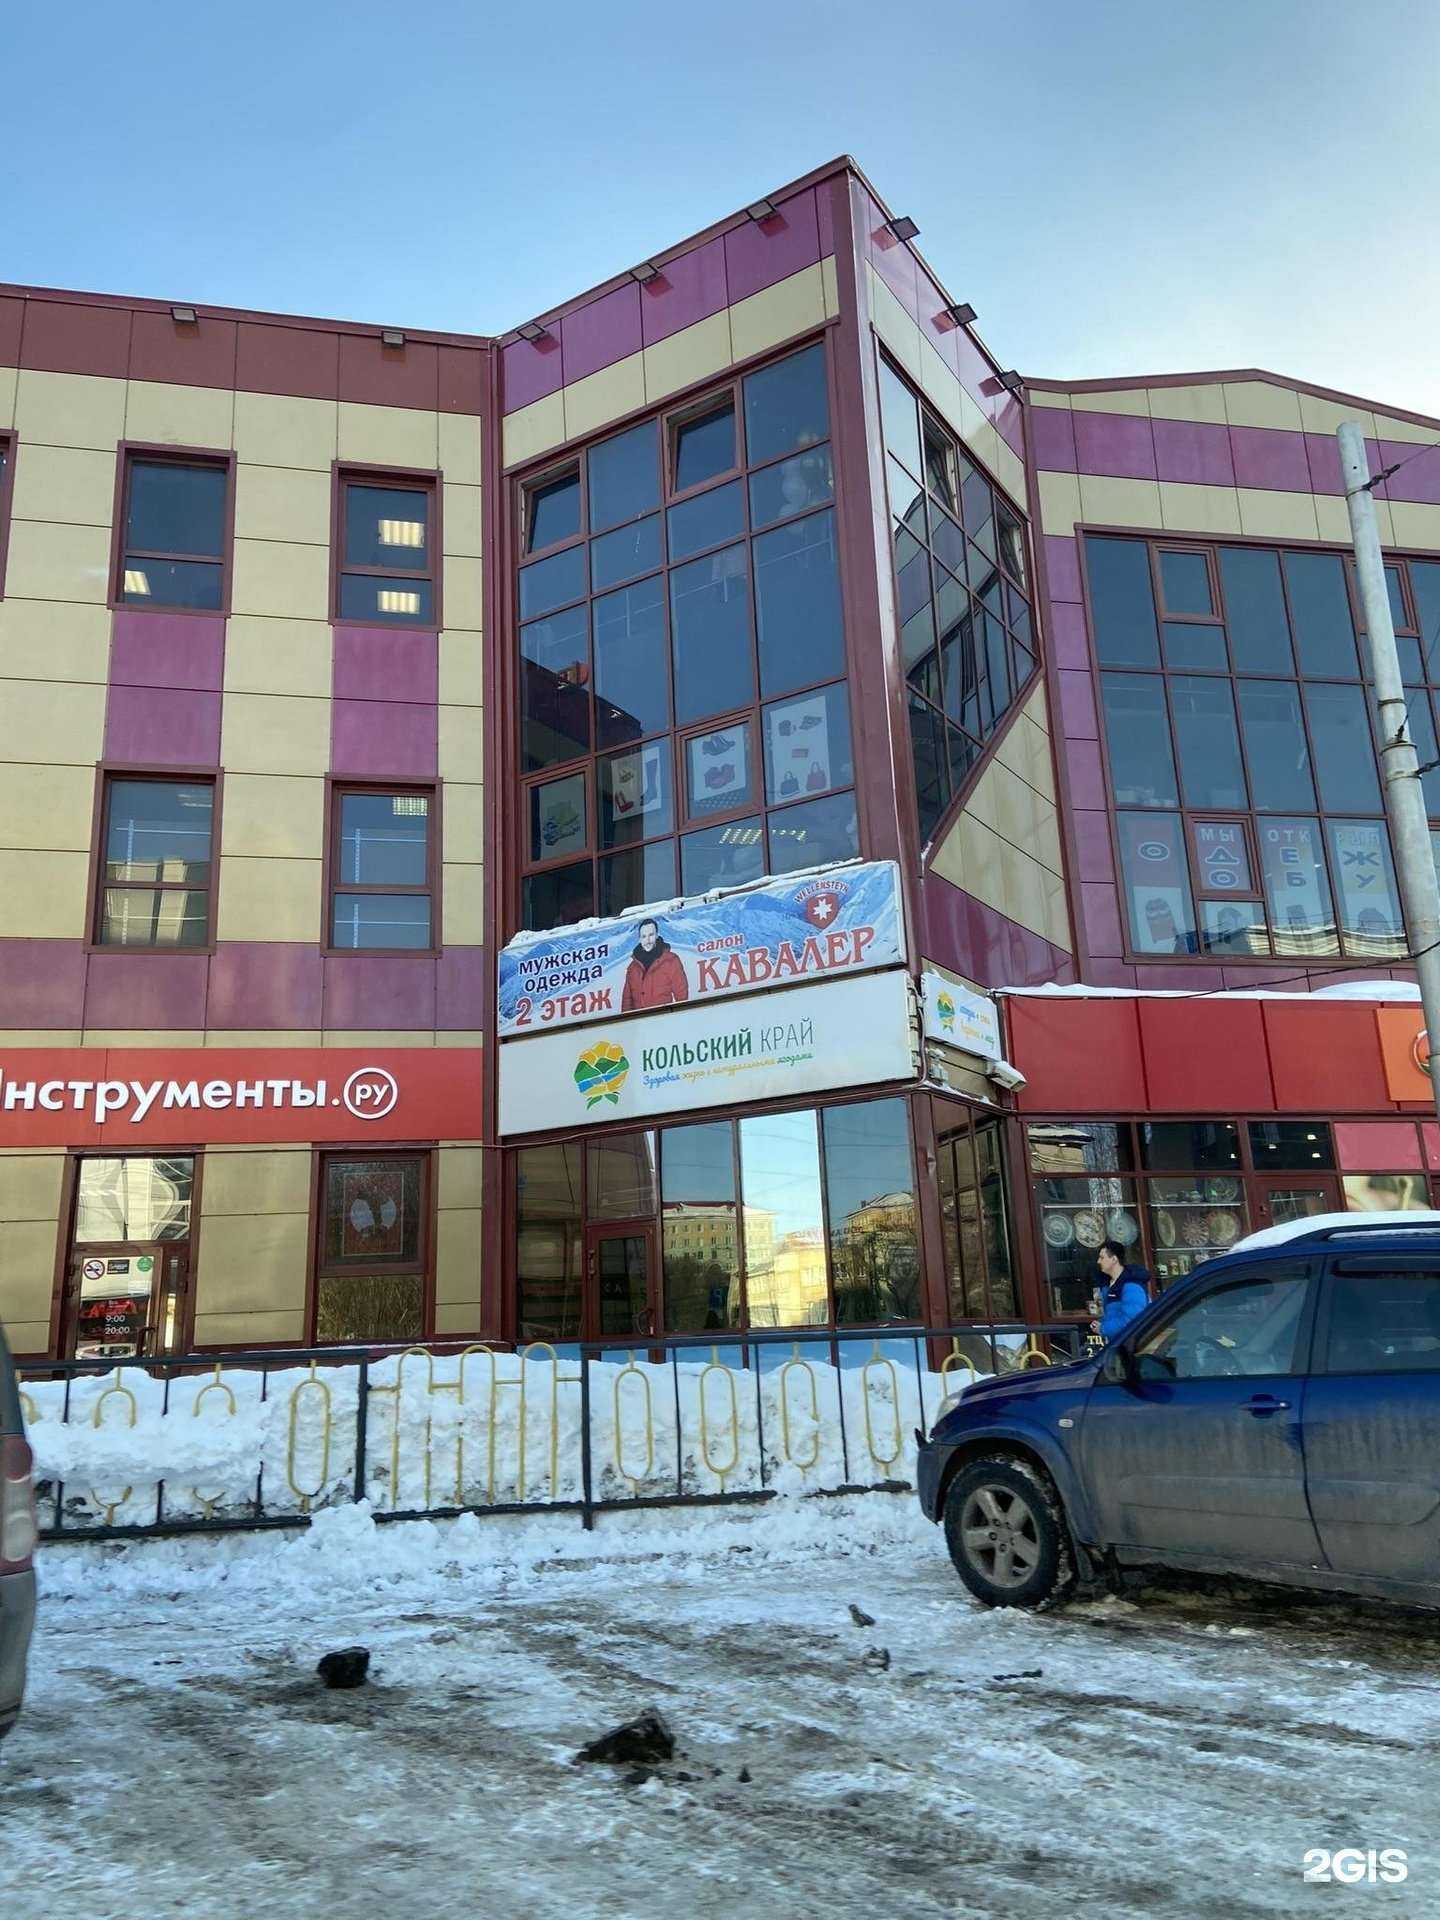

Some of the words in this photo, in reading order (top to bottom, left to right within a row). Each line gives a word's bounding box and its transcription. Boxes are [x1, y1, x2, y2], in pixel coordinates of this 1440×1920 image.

[1138, 841, 1380, 866] ОДЕЖ
[1208, 869, 1377, 889] ОБУ
[697, 934, 744, 953] салон
[519, 944, 609, 976] мужская
[697, 926, 875, 993] КАВАЛЕР
[525, 964, 603, 993] одежда
[516, 997, 532, 1026] 2
[540, 987, 613, 1022] этаж
[642, 1027, 752, 1072] КОЛЬСКИЙ
[760, 1016, 814, 1053] КРАЙ
[0, 1067, 390, 1124] нструменты.ру
[104, 1314, 126, 1323] 9:00
[104, 1326, 131, 1336] 20:00
